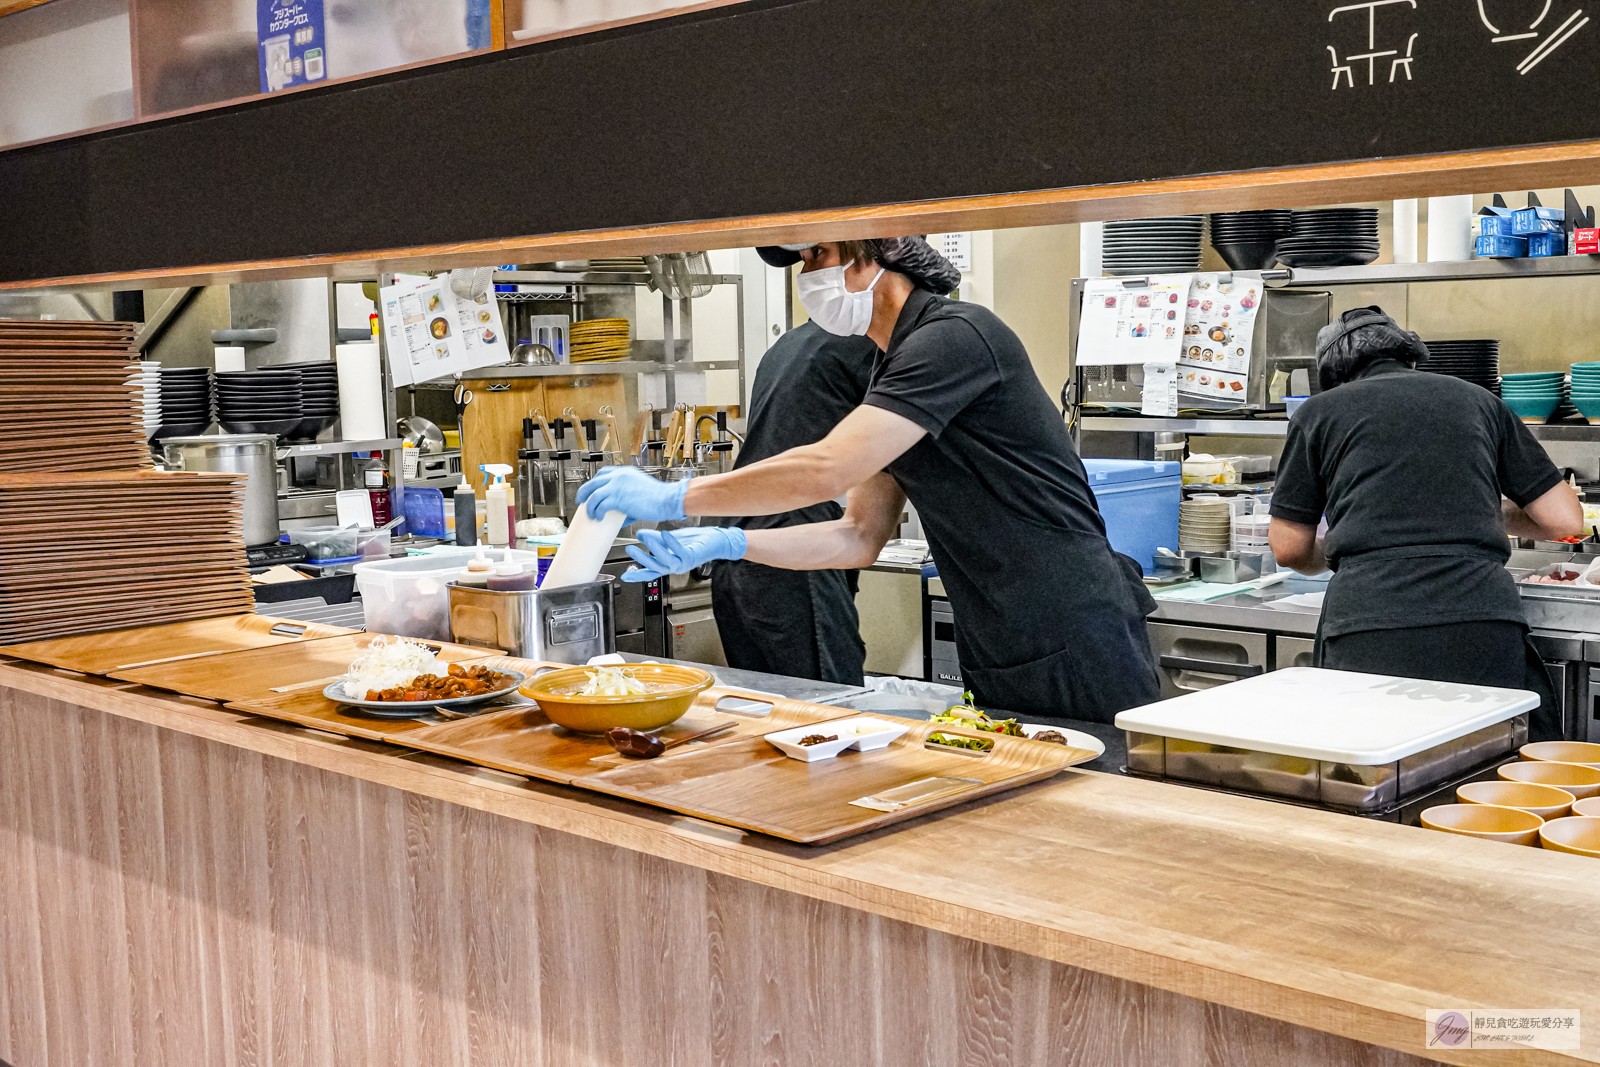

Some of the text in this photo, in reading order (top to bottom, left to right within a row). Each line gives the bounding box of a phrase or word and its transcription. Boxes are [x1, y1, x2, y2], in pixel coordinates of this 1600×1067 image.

[269, 13, 309, 32] カウンタークロス
